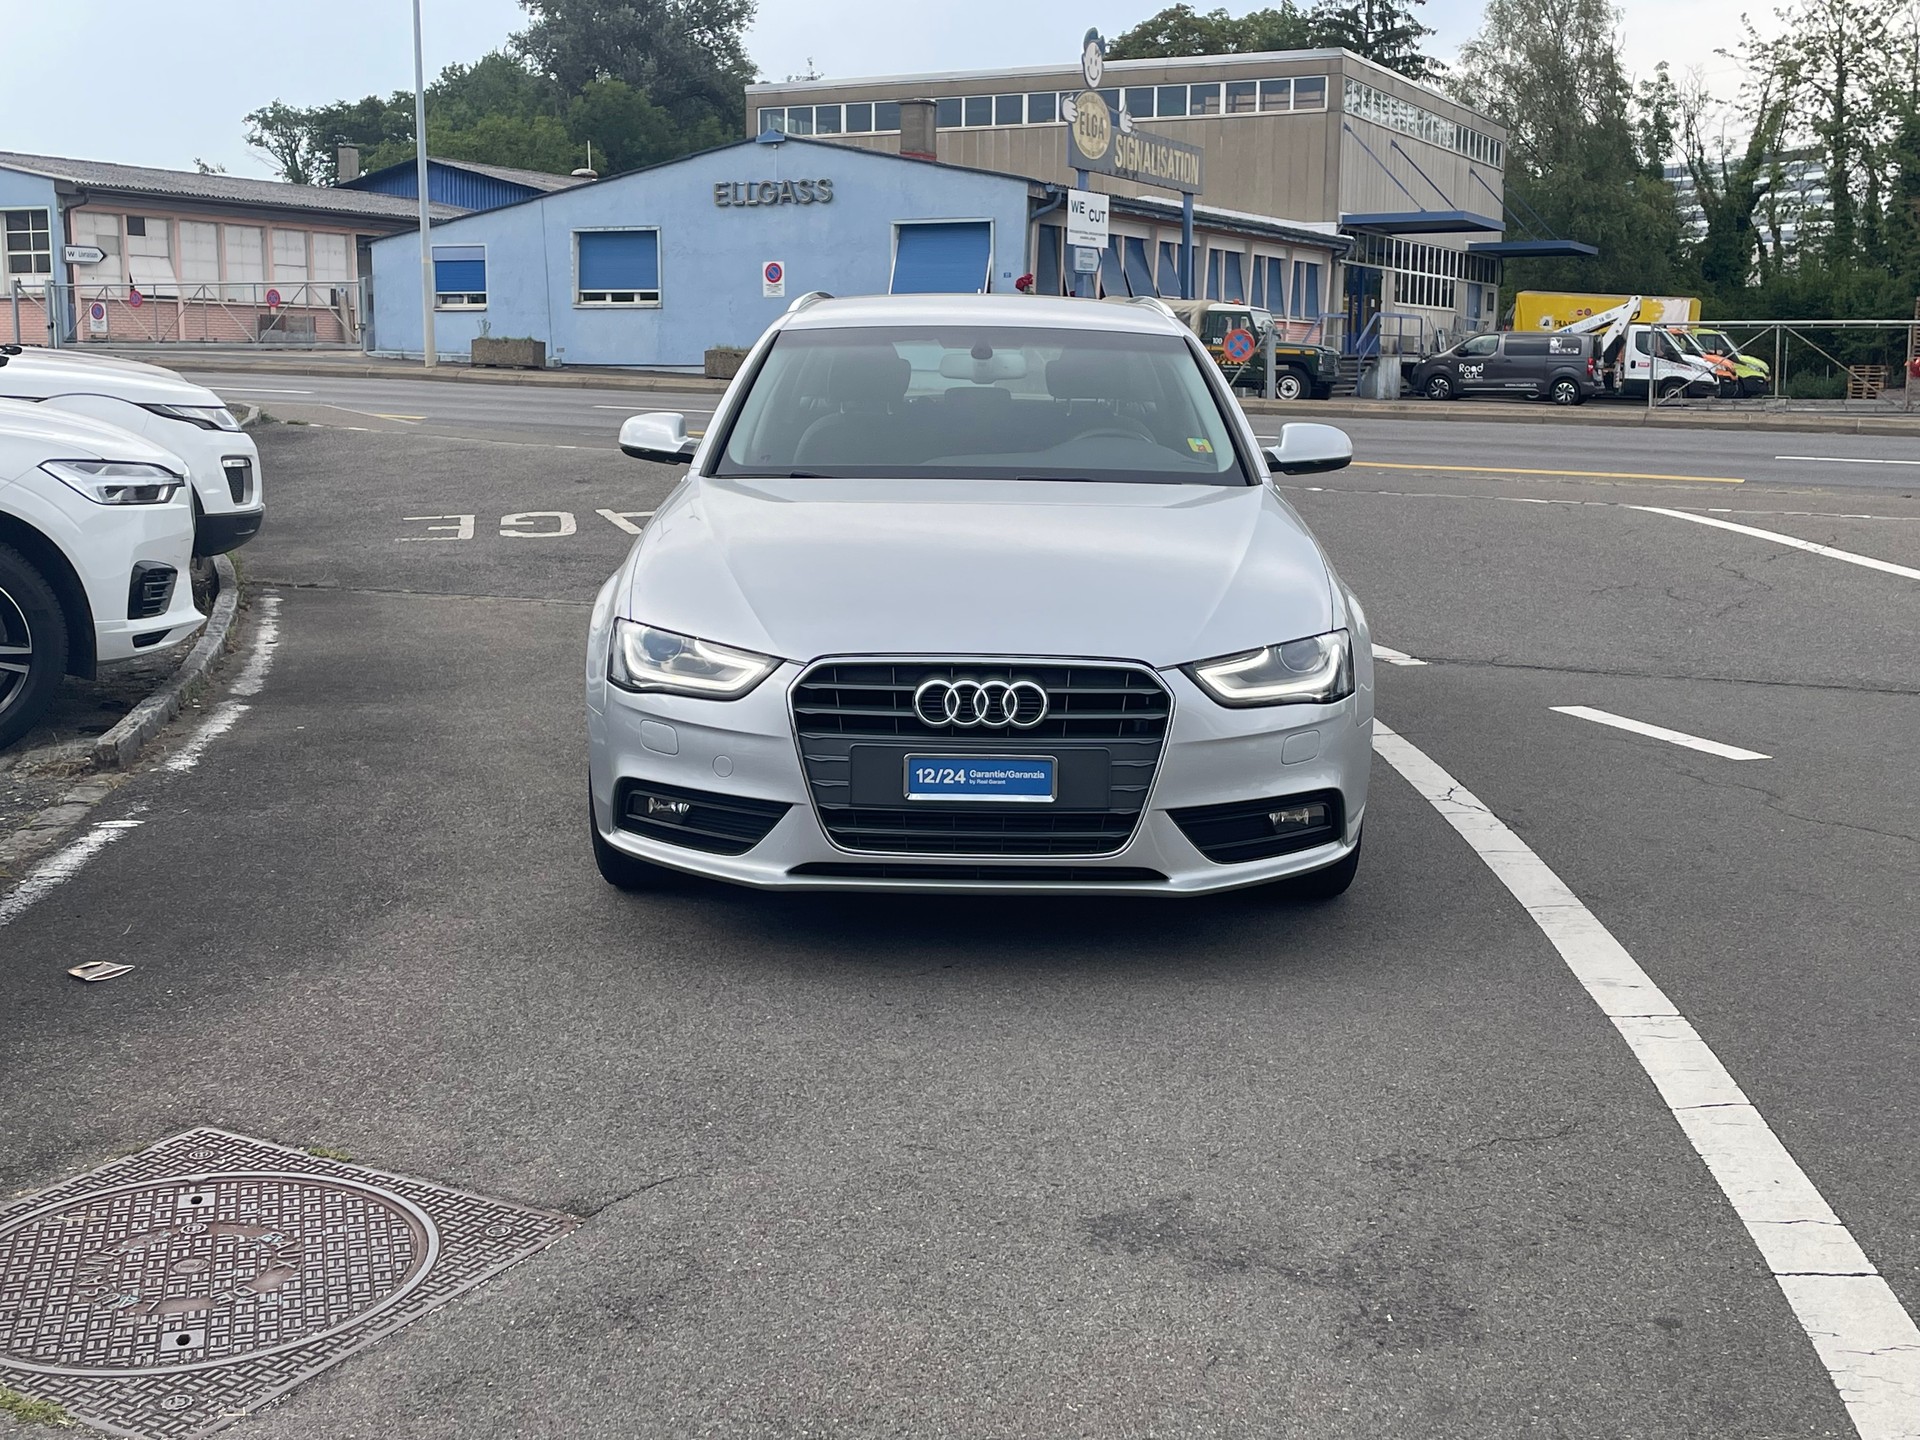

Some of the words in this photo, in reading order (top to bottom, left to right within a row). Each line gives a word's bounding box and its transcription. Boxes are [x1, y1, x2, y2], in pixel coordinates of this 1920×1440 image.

[1080, 111, 1105, 140] ELGA
[1114, 134, 1199, 185] SIGNALISATION
[714, 179, 834, 207] ELLGASS
[1071, 199, 1086, 214] WE
[1088, 208, 1107, 223] CUT
[1212, 337, 1223, 345] 100
[1458, 362, 1484, 373] Road
[395, 508, 658, 541] AGE
[915, 768, 967, 785] 12/24
[969, 769, 1045, 780] Garantie/Garanzia
